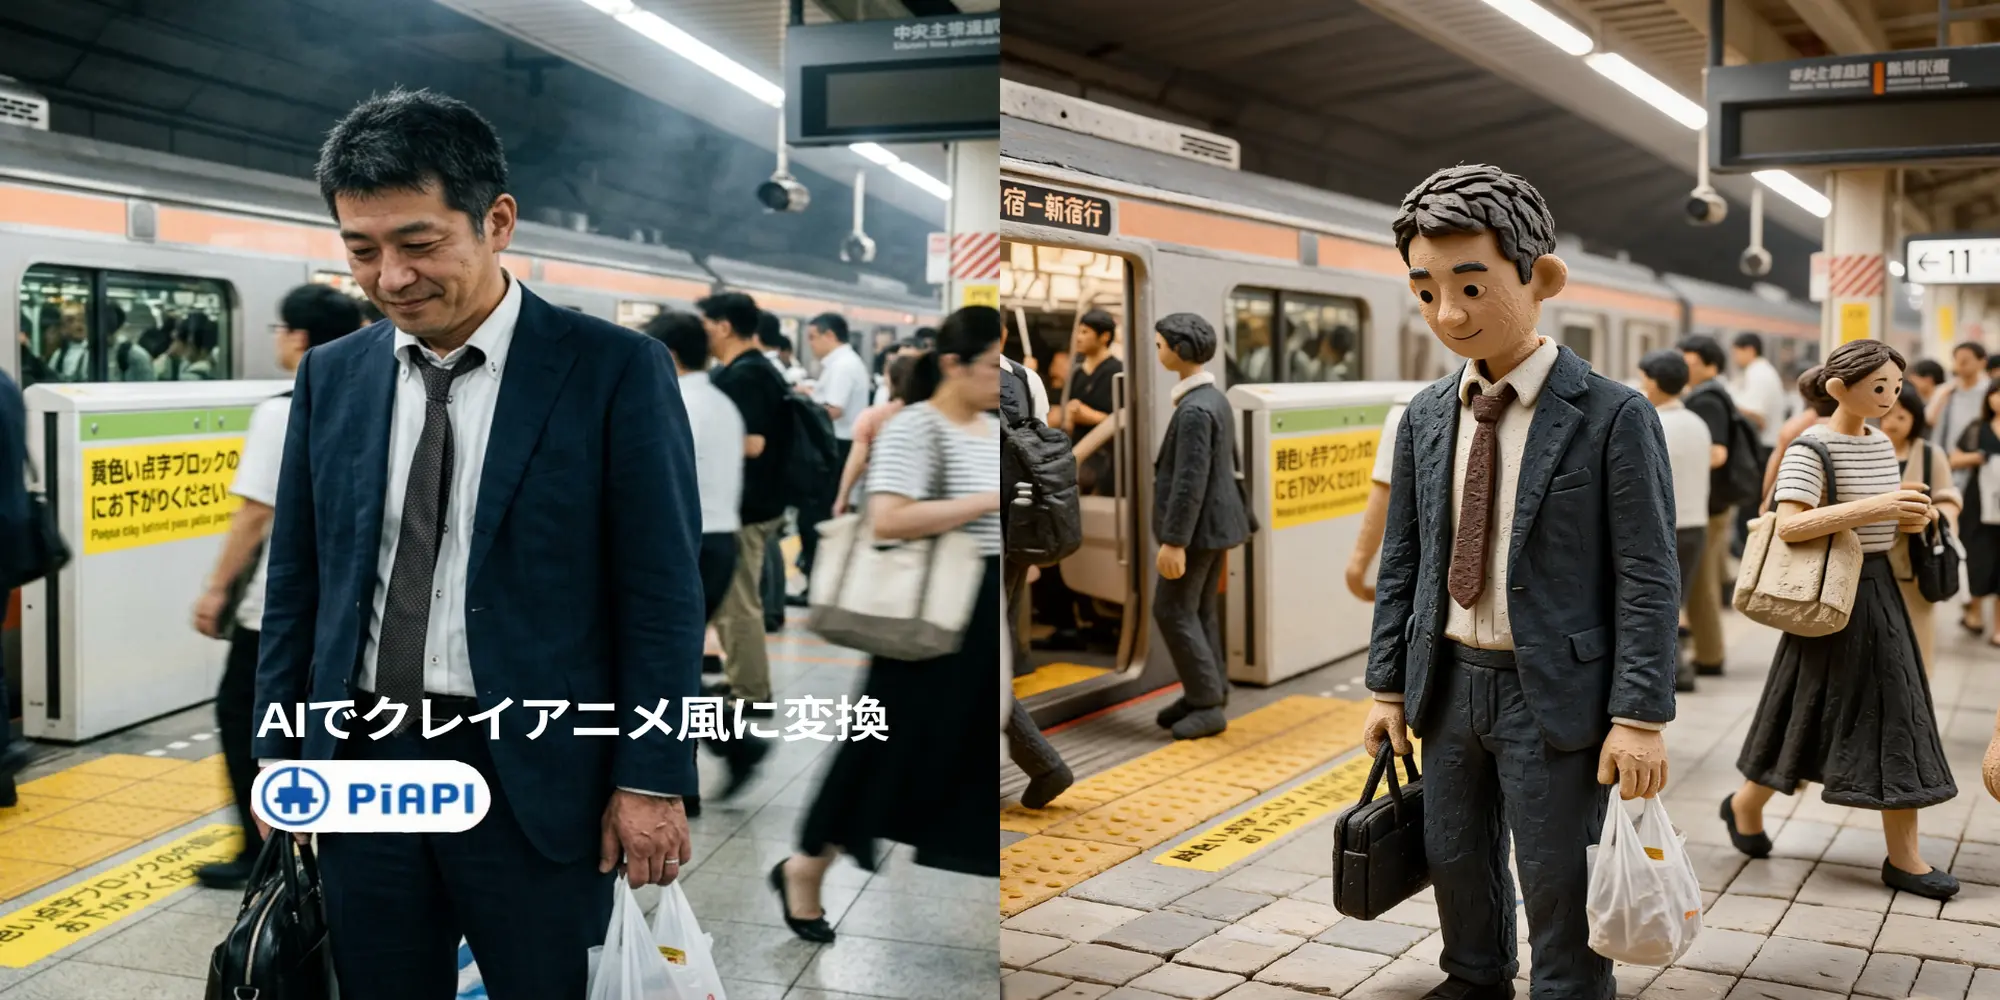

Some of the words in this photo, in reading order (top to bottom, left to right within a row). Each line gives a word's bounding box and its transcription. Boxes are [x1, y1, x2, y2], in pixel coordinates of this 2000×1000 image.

[1000, 184, 1103, 228] 宿ー新宿行
[1948, 249, 1970, 275] 11
[91, 482, 227, 520] にお下がりください
